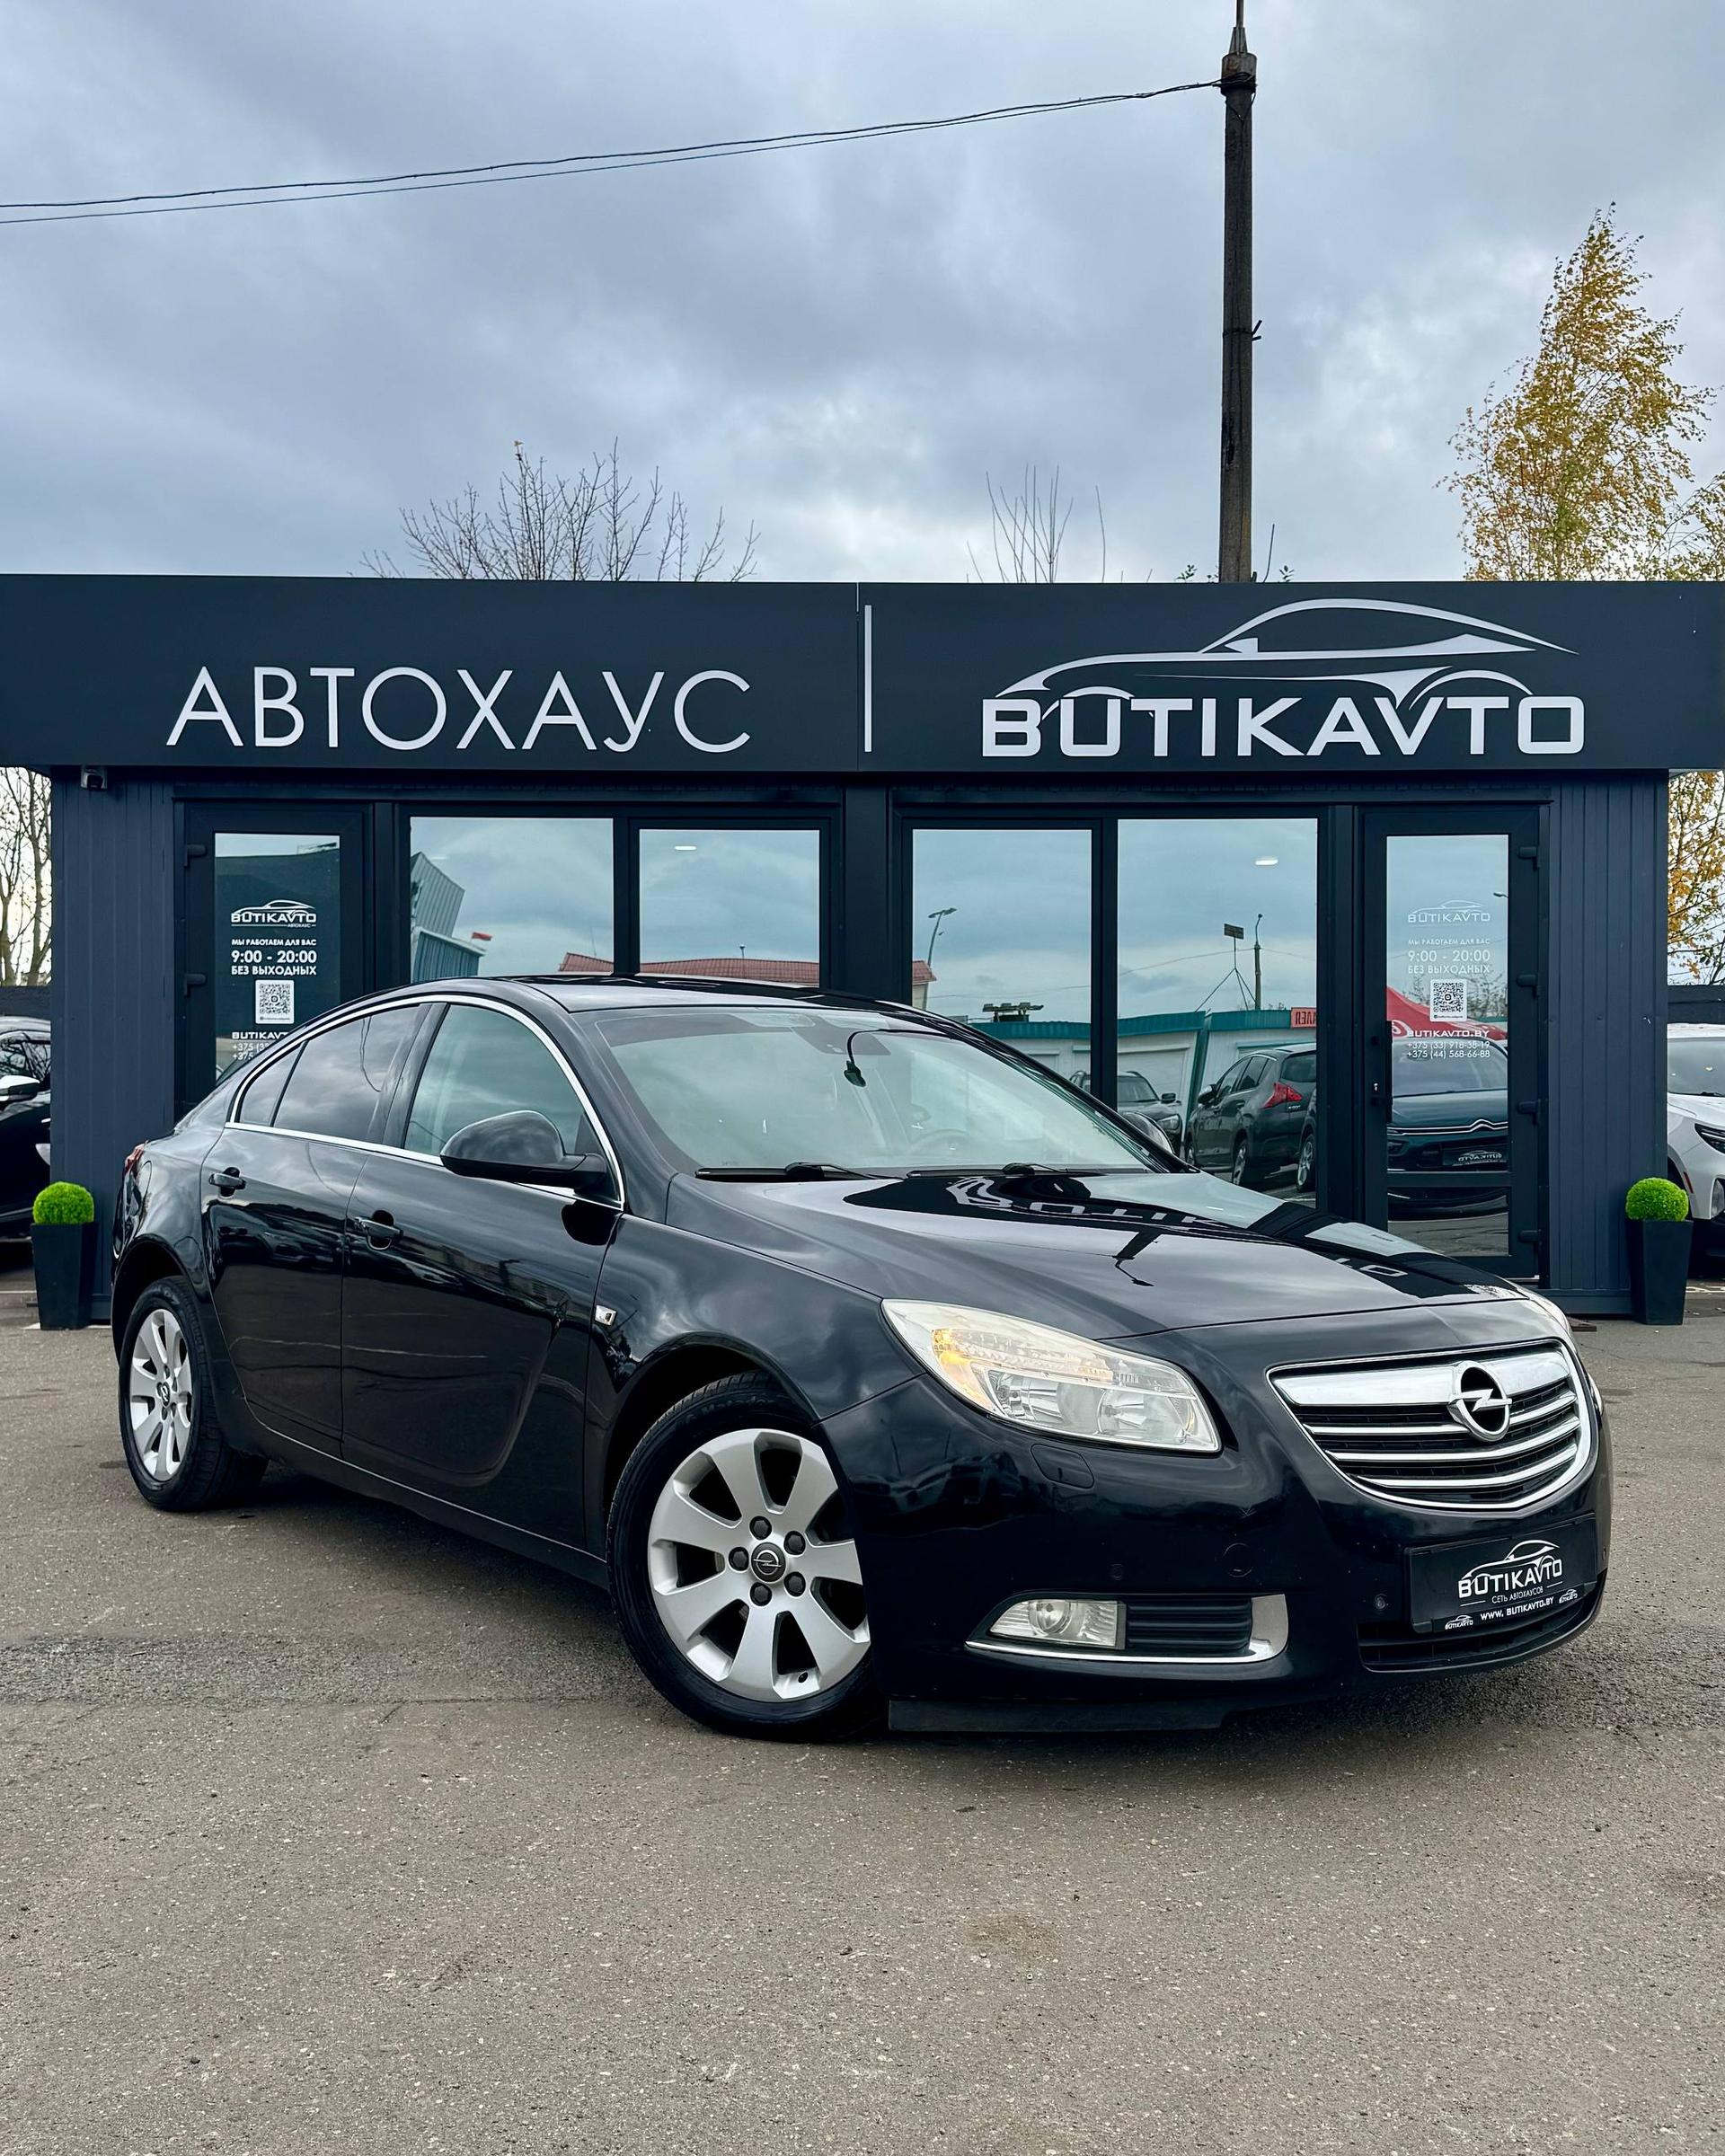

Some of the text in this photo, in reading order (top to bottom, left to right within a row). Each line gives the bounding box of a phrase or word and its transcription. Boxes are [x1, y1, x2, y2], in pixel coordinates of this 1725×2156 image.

[165, 665, 751, 754] АВТОХАУС
[981, 695, 1585, 757] BUTIKAVTO
[231, 913, 316, 923] BUTIKAVTO
[1408, 912, 1491, 923] BUTIKAVTO
[231, 950, 262, 964] 9:00
[277, 950, 317, 964] 20:00
[1408, 950, 1438, 963] 9:00
[1453, 950, 1491, 962] 20:00
[231, 966, 316, 976] БЕЗ ВЫХОДНЫХ
[1408, 964, 1491, 975] БЕЗ ВЫХОДНЫХ
[1407, 1029, 1490, 1038] BUTIKAVTO.BY
[232, 1042, 253, 1051] +375
[1407, 1041, 1428, 1049] +375
[1430, 1041, 1446, 1050] (33)
[1407, 1050, 1491, 1059] +375 (44) 568-66-88
[1458, 1559, 1562, 1599] BUTIKAVTO
[1491, 1586, 1544, 1604] СЕТЬ АВТОХАУСОВ
[1480, 1596, 1554, 1621] WWW. BUTIKAVTO.BY
